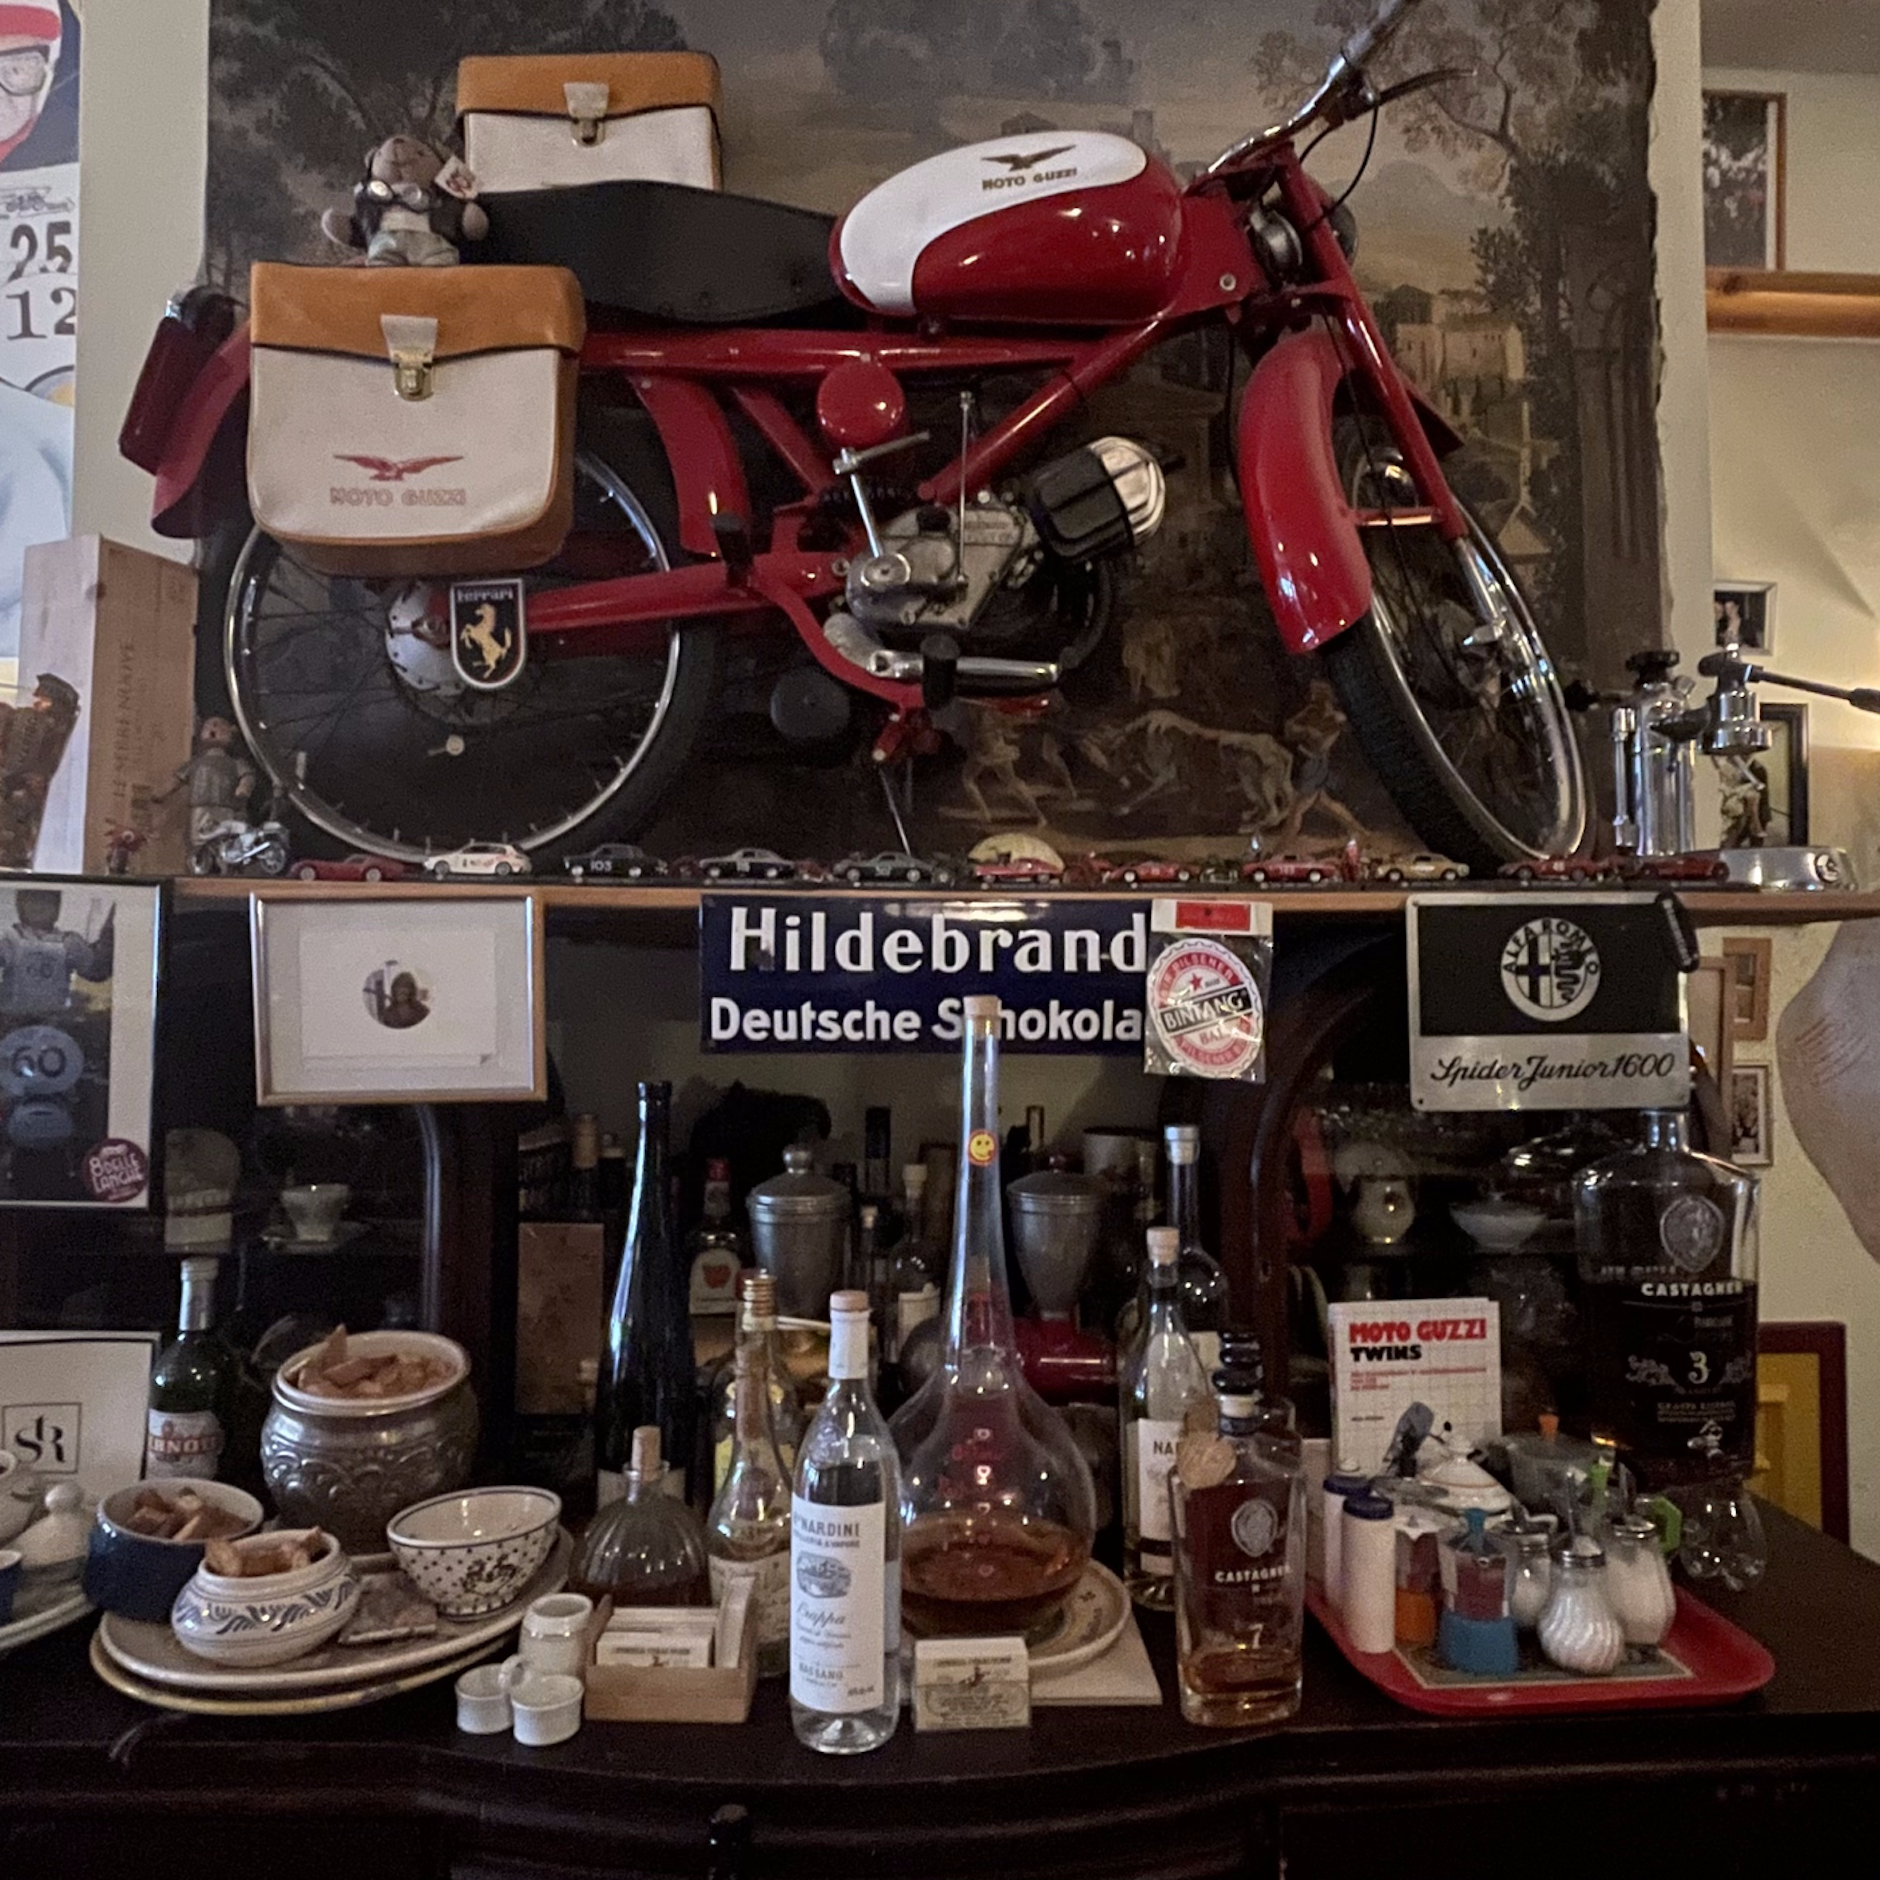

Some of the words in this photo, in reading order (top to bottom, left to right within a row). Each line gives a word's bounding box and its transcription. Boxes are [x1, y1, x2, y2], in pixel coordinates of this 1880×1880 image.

[982, 175, 1026, 191] MOTO
[1033, 167, 1077, 184] GUZZI
[6, 287, 77, 340] 12
[329, 488, 393, 506] MOTO
[401, 488, 467, 506] GUZZI
[591, 860, 612, 871] 103
[730, 907, 1147, 973] Hildebrand
[1502, 926, 1538, 974] ALFA
[711, 997, 919, 1042] Deutsche
[1163, 992, 1244, 1031] BINTANG
[1610, 1053, 1675, 1078] 1600
[1641, 1281, 1744, 1297] CASTAGNER
[1350, 1321, 1411, 1344] MOTO
[1417, 1318, 1487, 1341] GUZZI
[1350, 1345, 1423, 1362] TWINS
[1688, 1351, 1709, 1384] 3
[800, 1516, 860, 1538] NARDINI
[1248, 1623, 1264, 1649] 7
